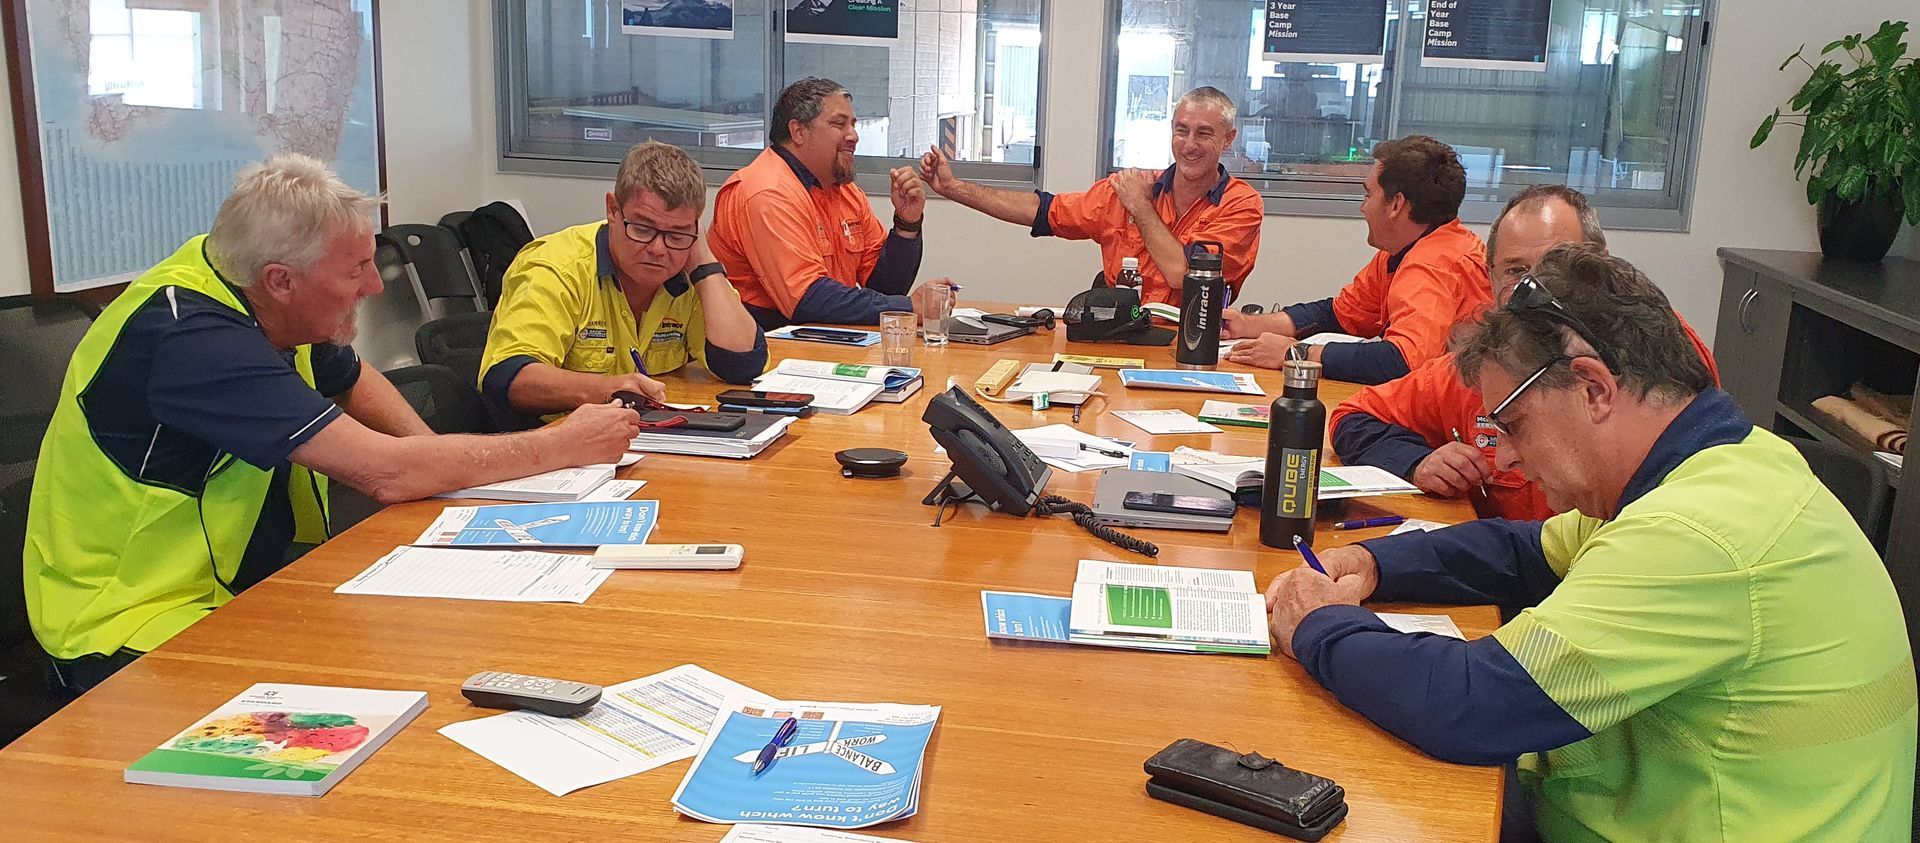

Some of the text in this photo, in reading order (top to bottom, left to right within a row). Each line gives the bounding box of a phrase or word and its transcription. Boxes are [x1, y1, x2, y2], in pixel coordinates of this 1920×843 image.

[1270, 2, 1296, 10] 3 Year
[1448, 1, 1457, 9] of
[1270, 11, 1289, 19] Base
[1430, 10, 1450, 18] Year
[1269, 20, 1292, 30] Camp
[1429, 19, 1450, 28] Base
[1268, 30, 1298, 38] Mission
[1428, 29, 1452, 38] Camp
[1427, 38, 1458, 47] Mission
[1197, 285, 1210, 330] intract
[1282, 453, 1300, 513] QUBE
[843, 735, 877, 748] WORK
[777, 744, 809, 760] LIF
[834, 744, 882, 772] BALANCE
[791, 796, 900, 814] way to turn?
[740, 804, 899, 823] Don't know which
